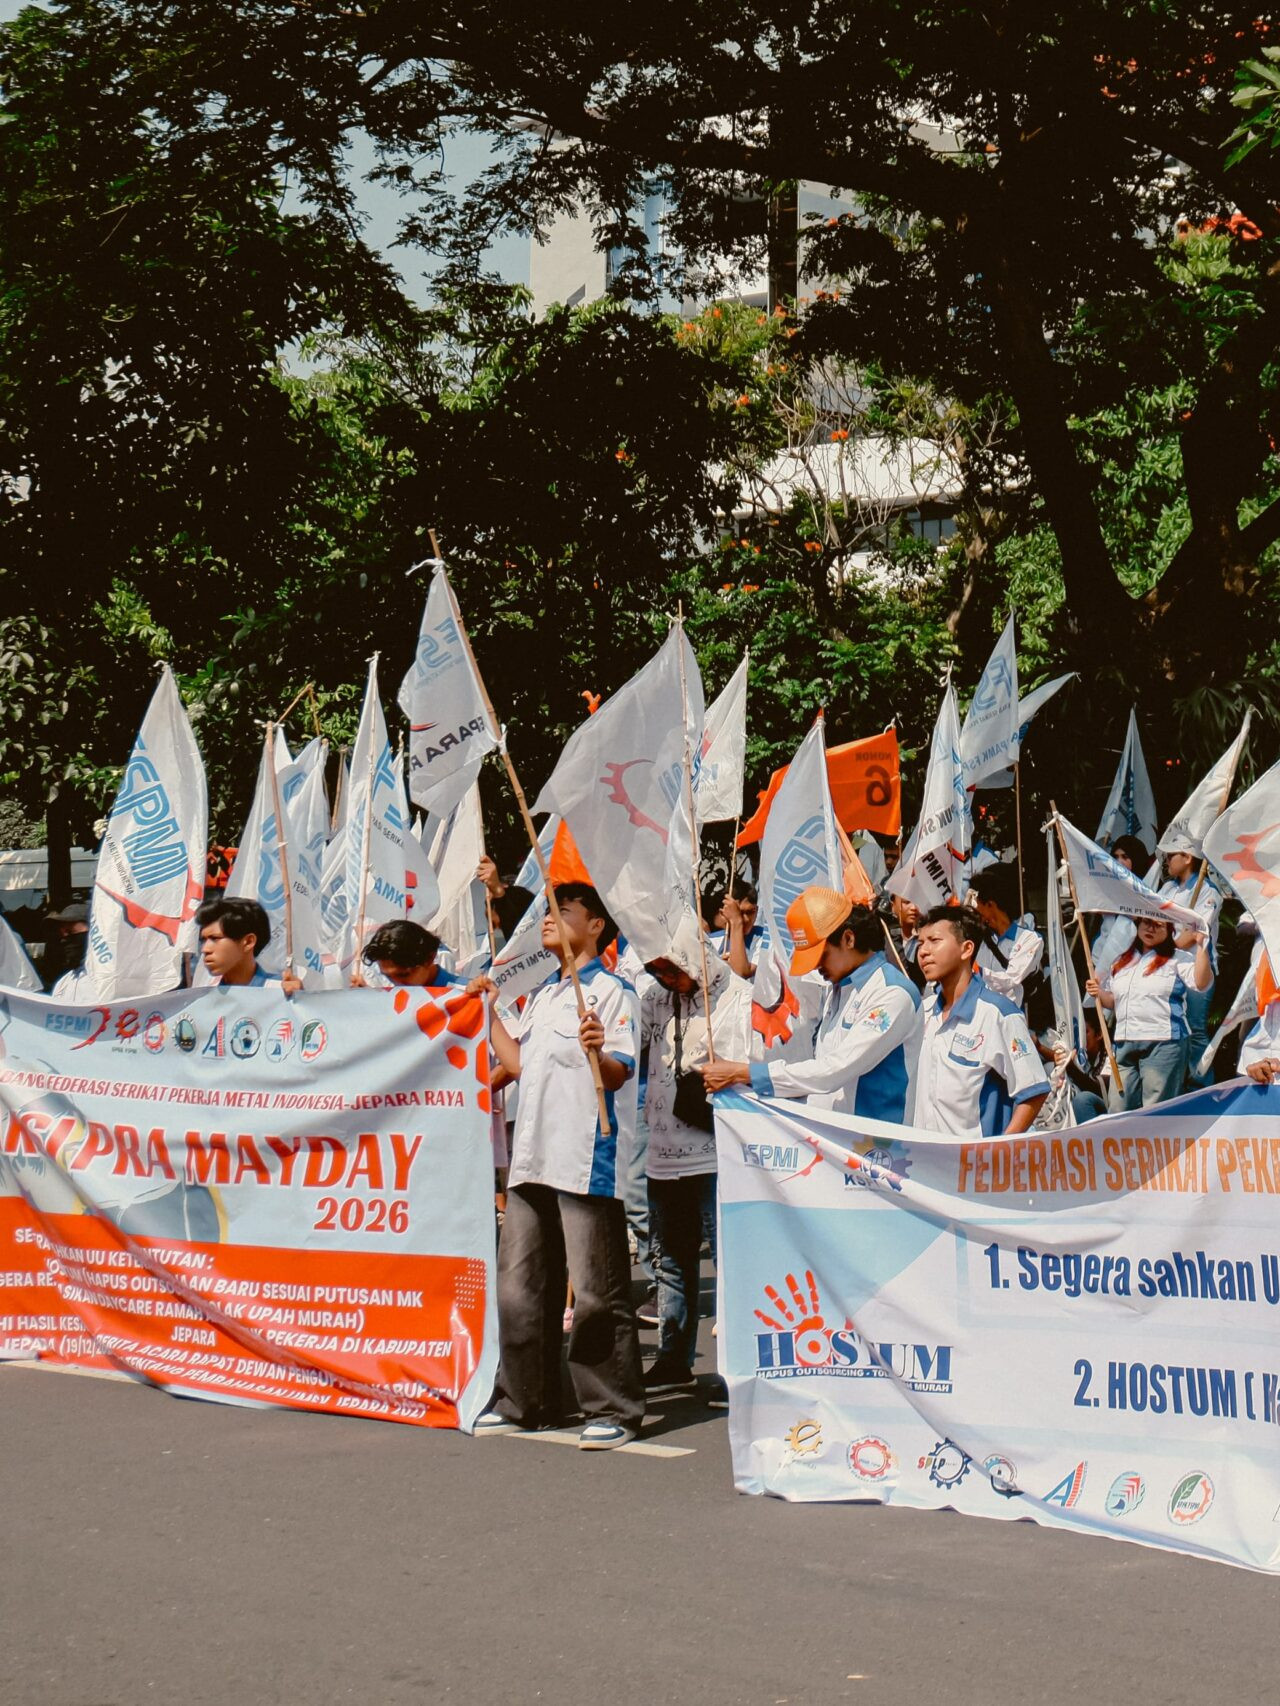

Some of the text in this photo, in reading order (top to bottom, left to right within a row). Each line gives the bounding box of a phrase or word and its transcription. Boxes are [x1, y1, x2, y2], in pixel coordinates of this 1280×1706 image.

[89, 912, 113, 964] ARANG
[45, 1013, 92, 1034] FSPMI
[47, 1075, 110, 1096] FEDERASI
[112, 1083, 169, 1102] SERIKAT
[168, 1087, 220, 1106] PEKERJA
[223, 1091, 271, 1109] METAL
[424, 1090, 465, 1108] RAYA
[70, 1121, 177, 1180] PRA
[183, 1131, 424, 1192] MAYDAY
[957, 1142, 1097, 1194] FEDERASI
[1105, 1137, 1210, 1194] SERIKAT
[312, 1196, 410, 1234] 2026
[86, 1250, 106, 1266] UU
[213, 1278, 260, 1298] BARU
[262, 1283, 311, 1302] SESUAI
[314, 1287, 393, 1307] PUTUSAN
[397, 1291, 424, 1308] MK
[983, 1242, 1010, 1289] 1.
[1018, 1246, 1131, 1297] Segera
[1138, 1250, 1254, 1302] sahkan
[171, 1326, 217, 1347] JEPARA
[247, 1305, 295, 1327] UPAH
[298, 1309, 366, 1334] MURAH)
[17, 1315, 58, 1331] HASIL
[138, 1344, 189, 1364] ACARA
[234, 1358, 286, 1381] DEWAN
[266, 1331, 338, 1352] PEKERJA
[341, 1337, 358, 1353] DI
[362, 1337, 453, 1358] KABUPATEN
[757, 1368, 794, 1380] HAPUS
[796, 1367, 864, 1377] OUTSOURCING
[914, 1383, 951, 1393] MURAH
[1073, 1359, 1100, 1408] 2.
[1108, 1361, 1238, 1418] HOSTUM
